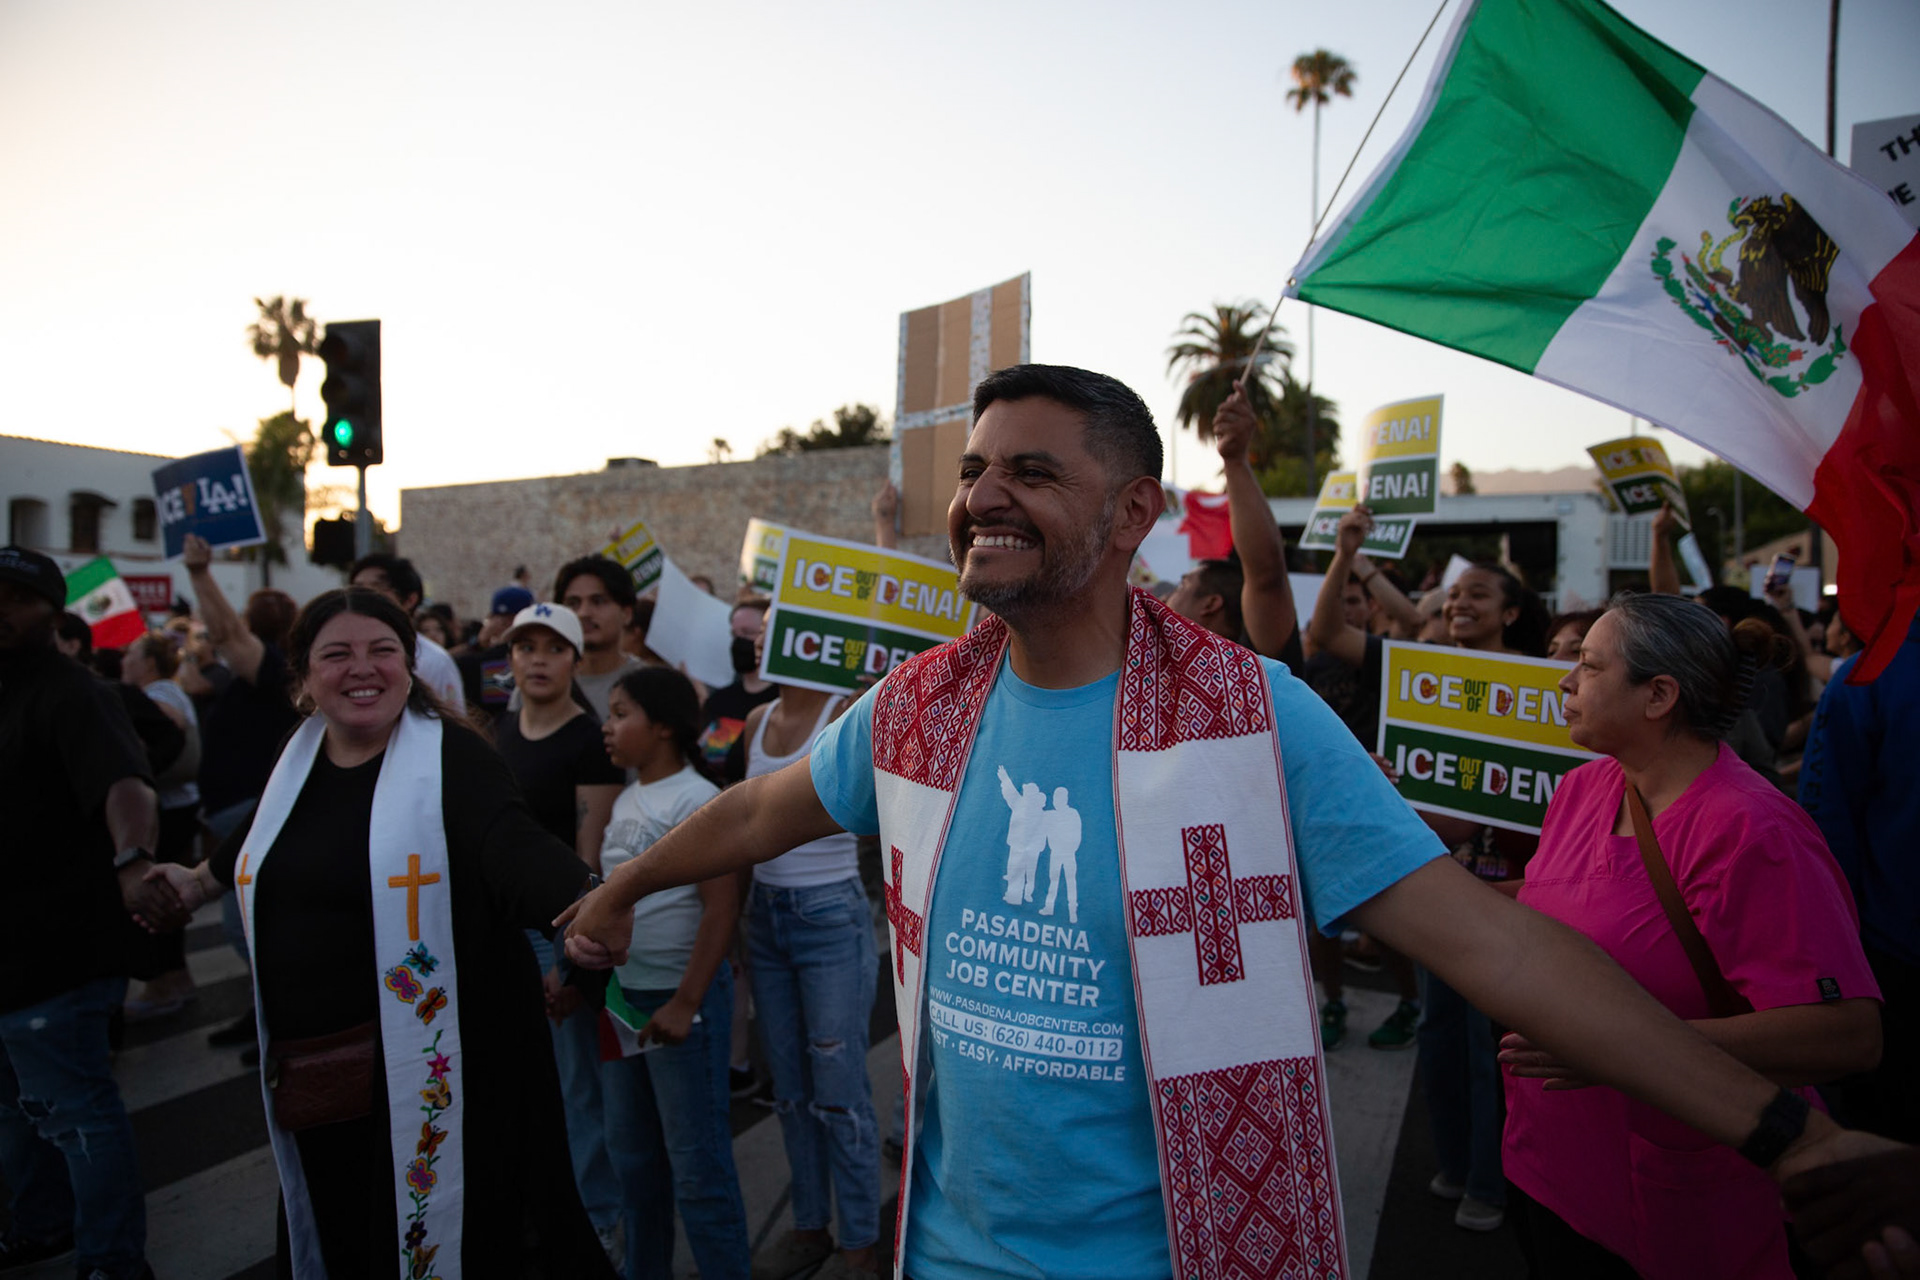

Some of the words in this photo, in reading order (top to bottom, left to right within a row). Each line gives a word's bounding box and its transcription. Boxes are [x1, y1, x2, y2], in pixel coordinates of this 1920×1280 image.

[793, 558, 855, 597] ICE
[856, 570, 878, 586] OUT
[857, 584, 873, 600] OF
[876, 574, 965, 622] DENA!
[782, 627, 844, 666] ICE
[844, 638, 867, 655] OUT
[845, 654, 860, 671] OF
[864, 642, 917, 674] DE
[1399, 669, 1462, 710] ICE
[1464, 678, 1488, 697] OUT
[1467, 695, 1482, 713] OF
[1395, 744, 1458, 786] ICE
[1459, 756, 1482, 774] OUT
[1461, 773, 1476, 791] OF
[961, 908, 1091, 953] PASADENA
[945, 931, 1106, 981] COMMUNITY
[946, 959, 988, 988] JOB
[995, 971, 1100, 1008] CENTER
[929, 985, 1124, 1036] WWW.PASADENAJOBCENTER.COM
[930, 1004, 959, 1029] CALL
[964, 1019, 988, 1038] US:
[992, 1025, 1030, 1049] (626)
[1035, 1034, 1120, 1059] 440-0112
[959, 1040, 996, 1065] EASY
[1002, 1053, 1126, 1082] AFFORDABLE
